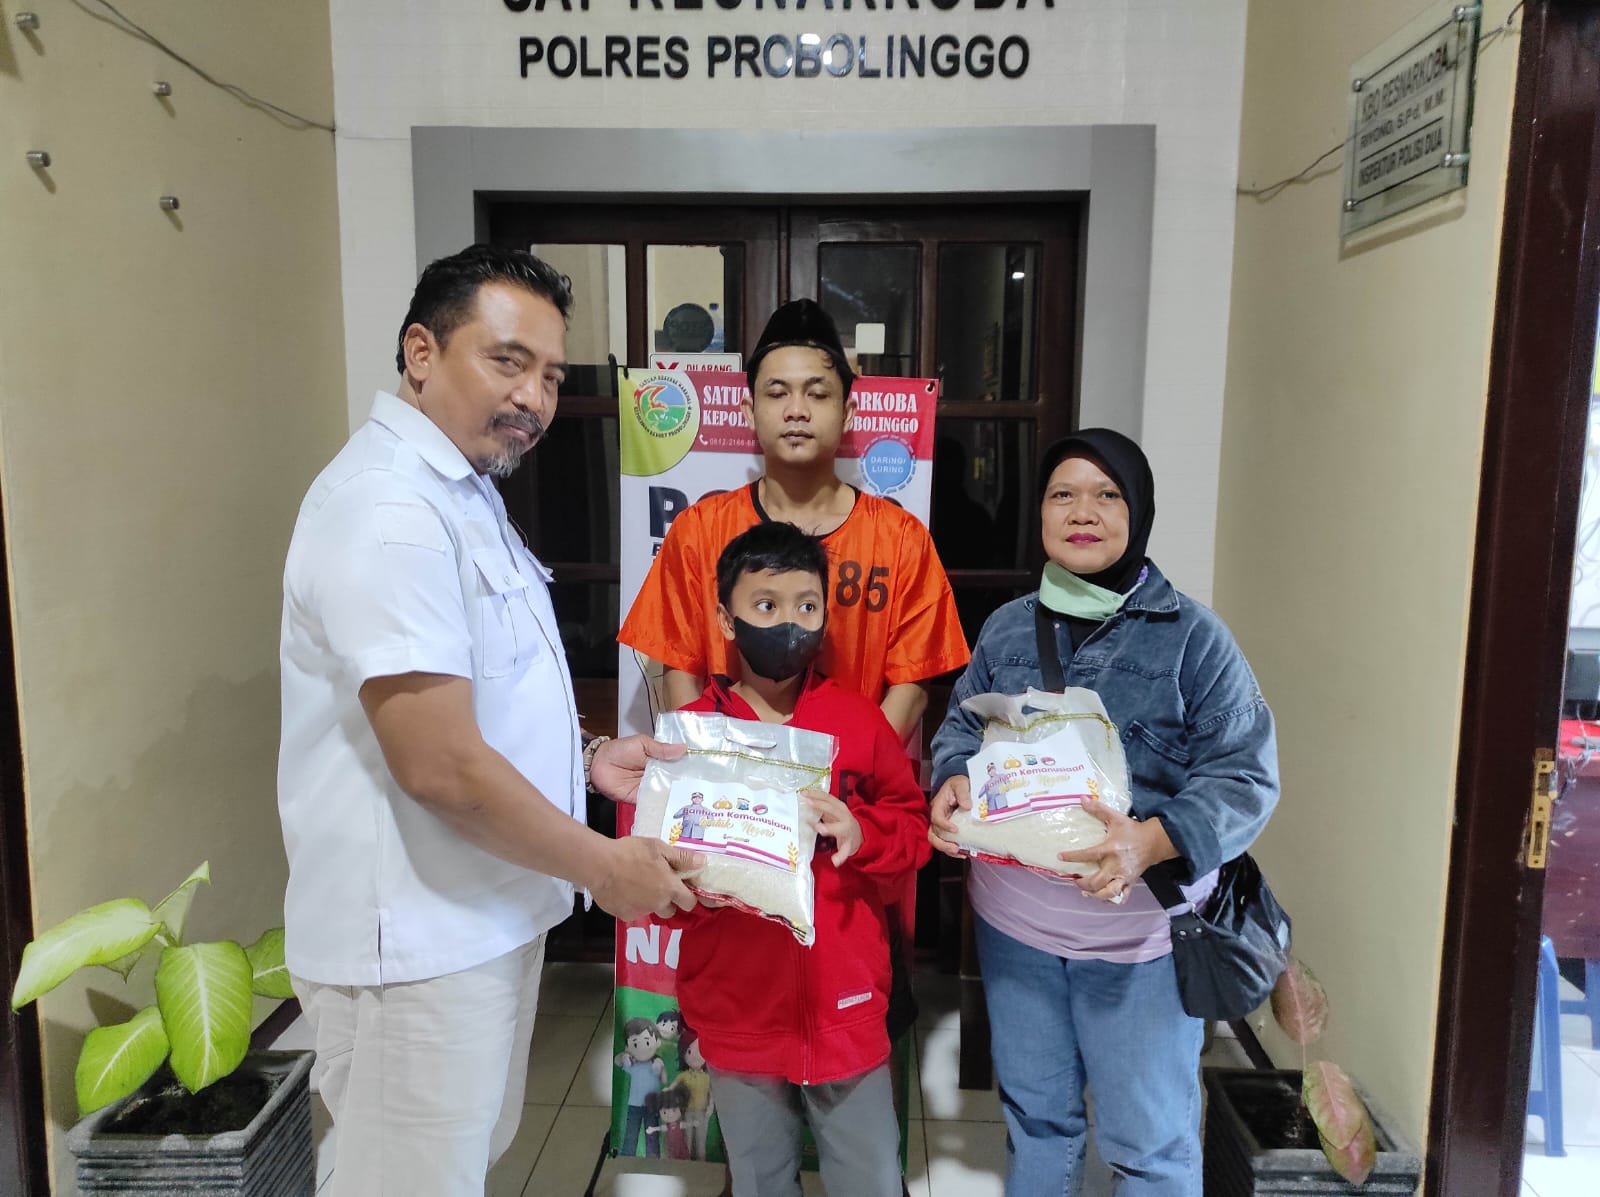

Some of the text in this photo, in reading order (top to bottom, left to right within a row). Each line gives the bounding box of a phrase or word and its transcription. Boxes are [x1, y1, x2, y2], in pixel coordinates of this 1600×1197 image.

[519, 33, 1030, 79] POLRES PROBOLINGGO
[872, 465, 904, 473] LURING
[835, 560, 890, 613] 85
[683, 807, 792, 833] Bantuan Kemanusiaan
